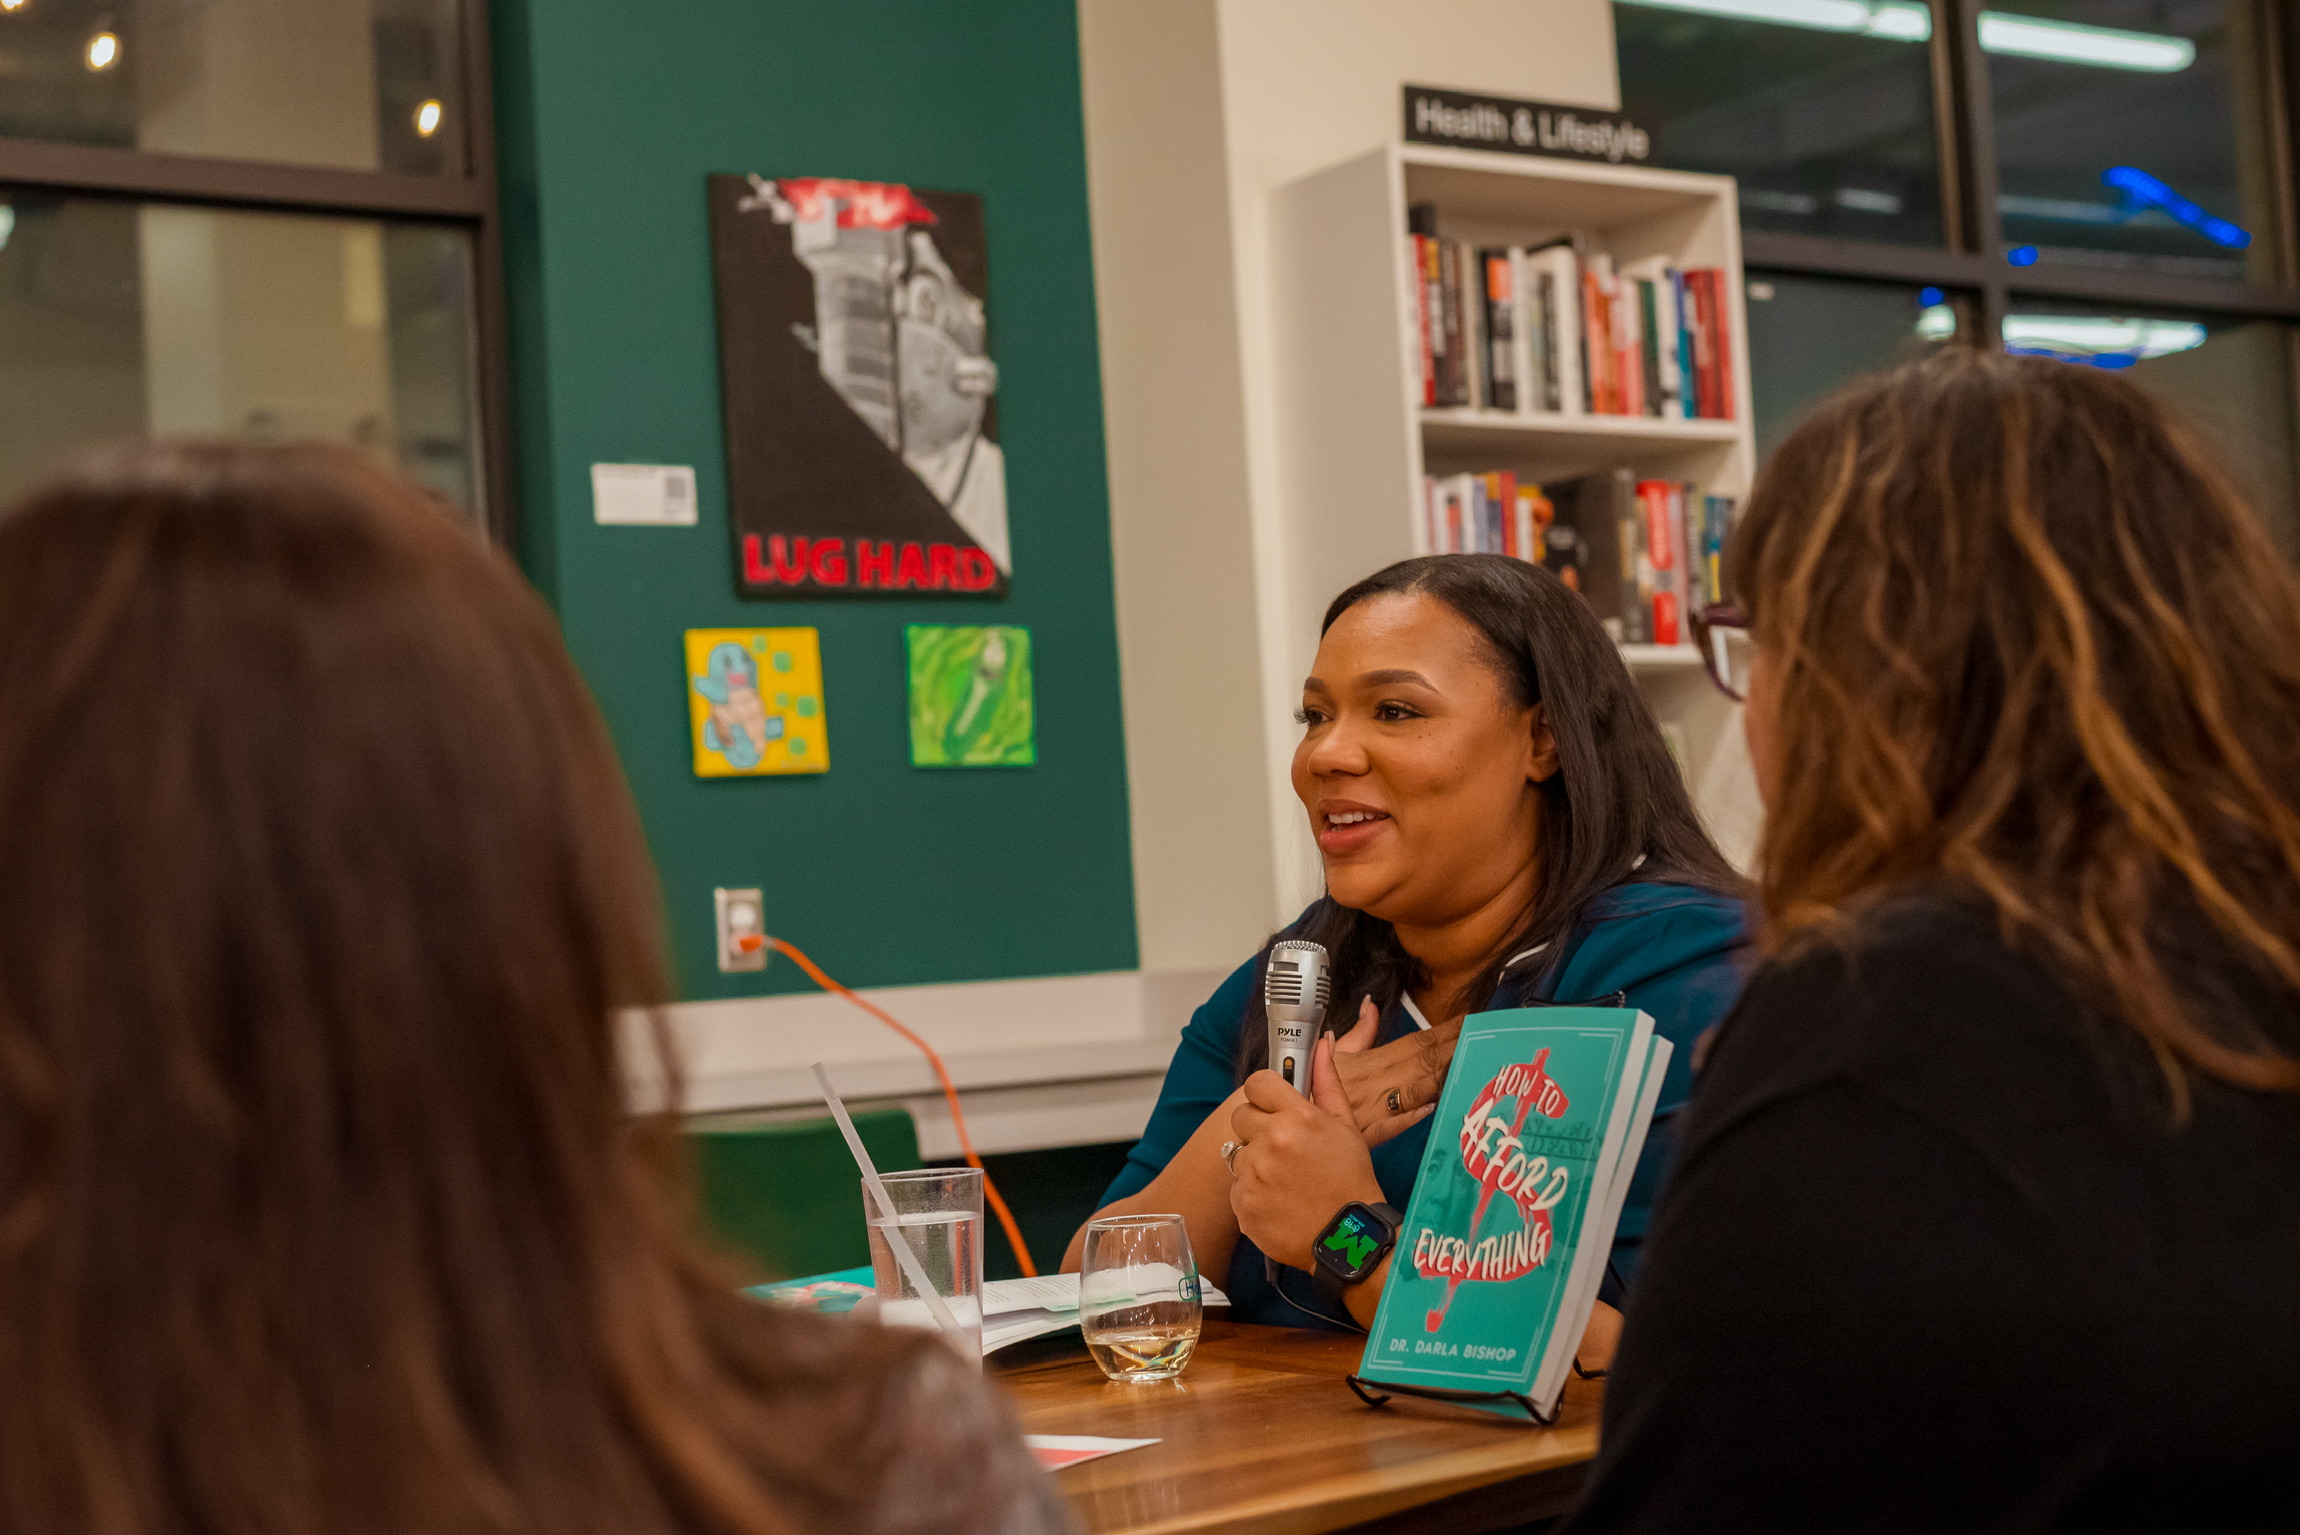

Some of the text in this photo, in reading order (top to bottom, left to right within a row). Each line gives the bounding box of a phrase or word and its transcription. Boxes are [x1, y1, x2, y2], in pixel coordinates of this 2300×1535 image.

[1415, 97, 1650, 163] Health & Lifestyle
[743, 534, 998, 591] LUG HARD
[1278, 1028, 1301, 1036] PYLE
[1493, 1064, 1561, 1116] HOW TO
[1459, 1098, 1568, 1211] AFFORD
[1413, 1222, 1550, 1280] EVERYTHING
[1389, 1338, 1517, 1362] DR. DARLA BISHOP
